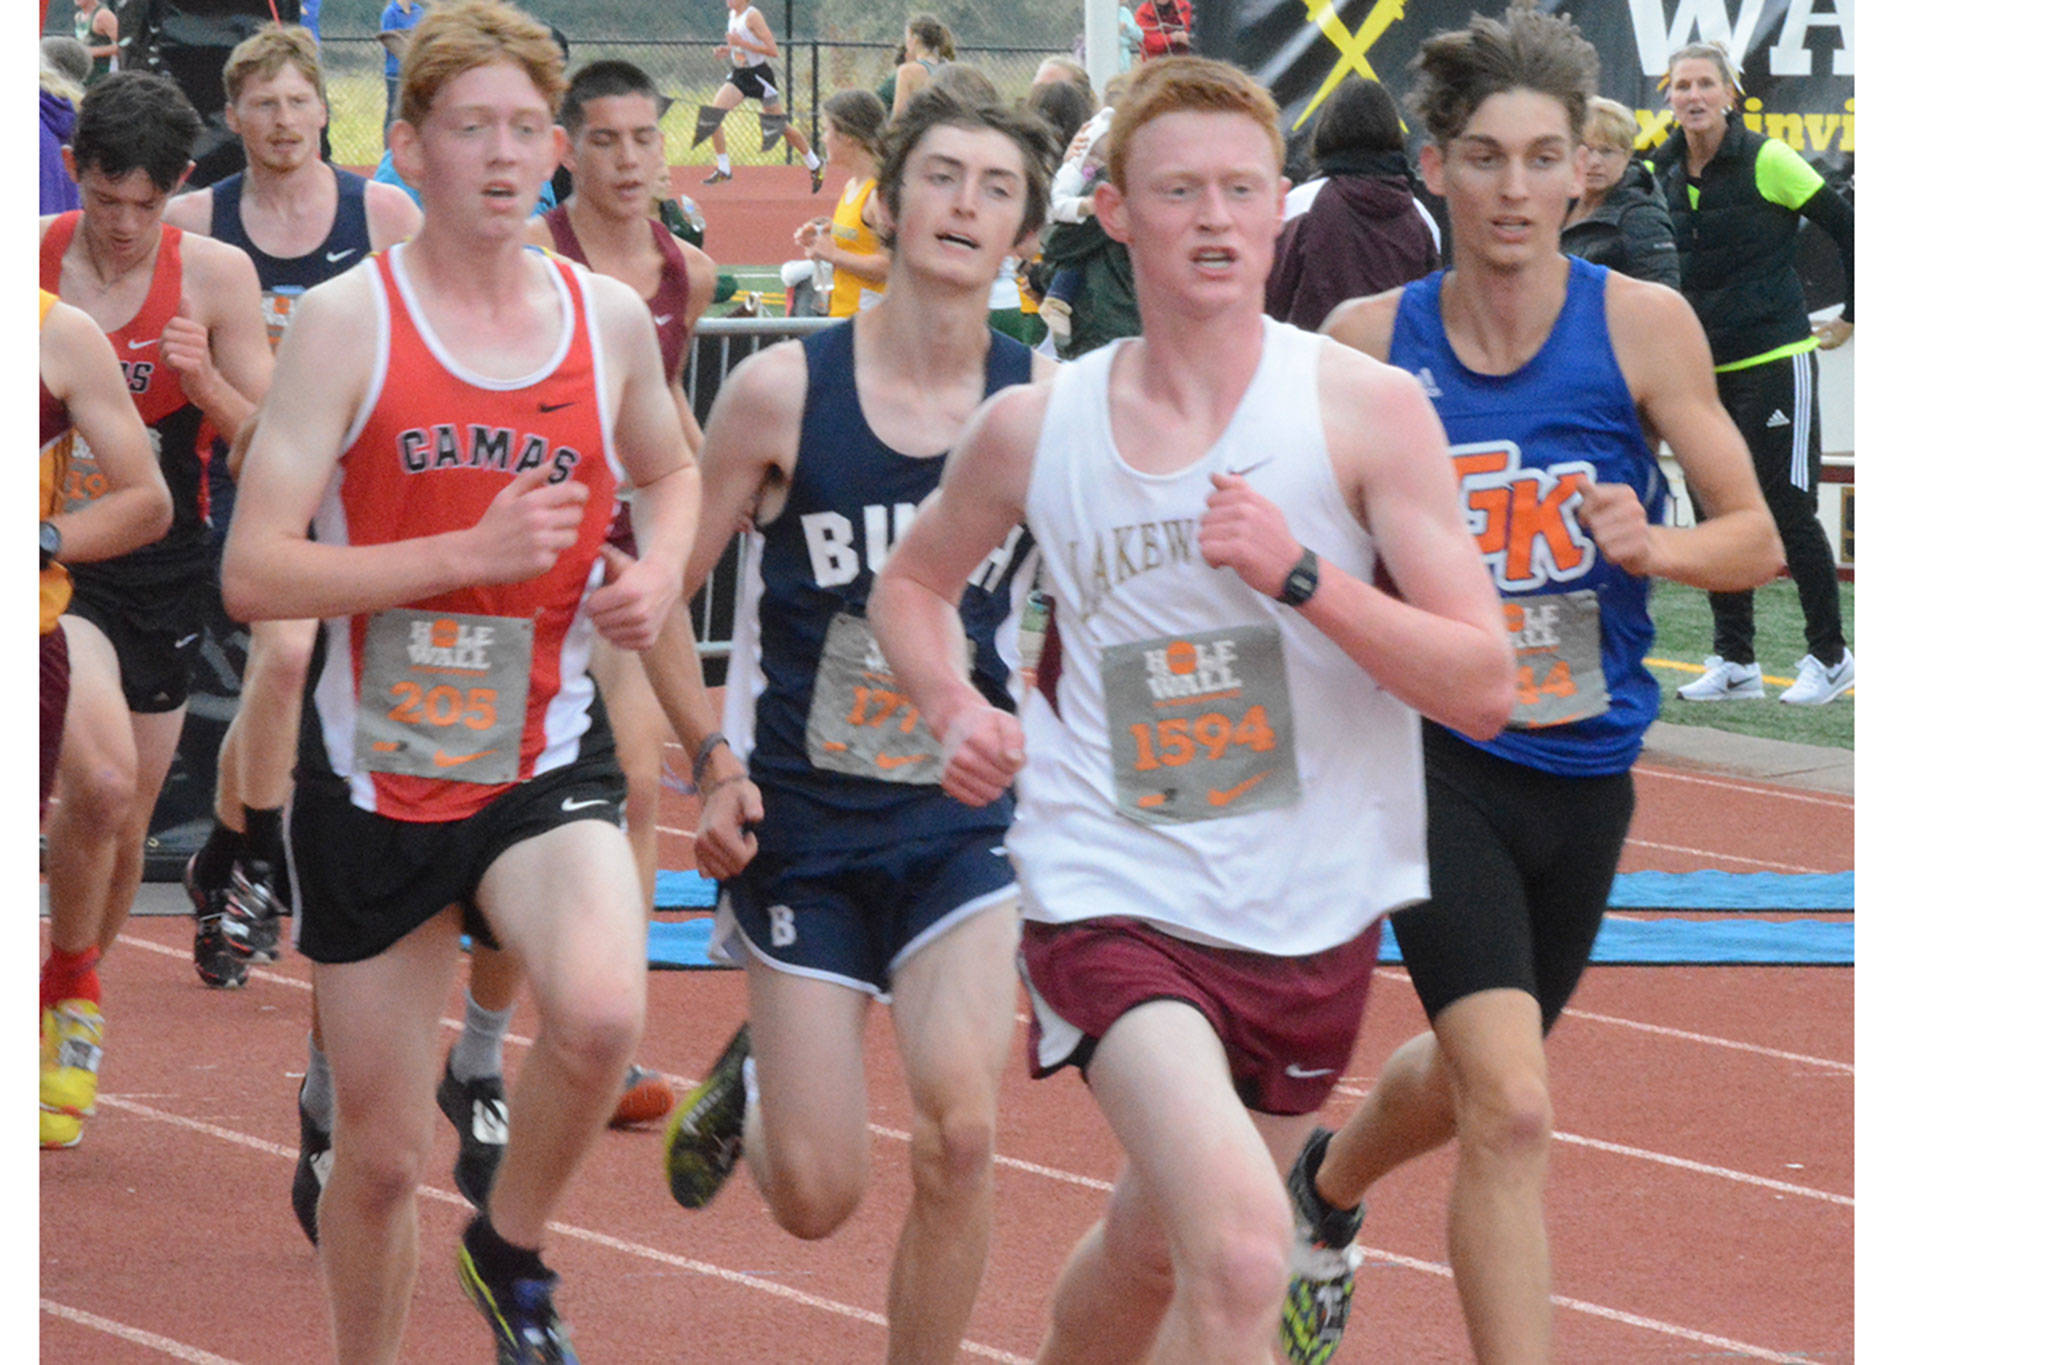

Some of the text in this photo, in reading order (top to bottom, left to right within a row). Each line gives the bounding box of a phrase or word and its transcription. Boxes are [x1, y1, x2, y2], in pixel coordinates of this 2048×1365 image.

[396, 423, 581, 487] CAMAS
[801, 502, 1024, 593] BUH
[407, 643, 492, 670] WALL
[388, 681, 499, 731] 205
[1148, 665, 1243, 699] WALL
[1130, 704, 1277, 772] 1594
[767, 904, 797, 947] B
